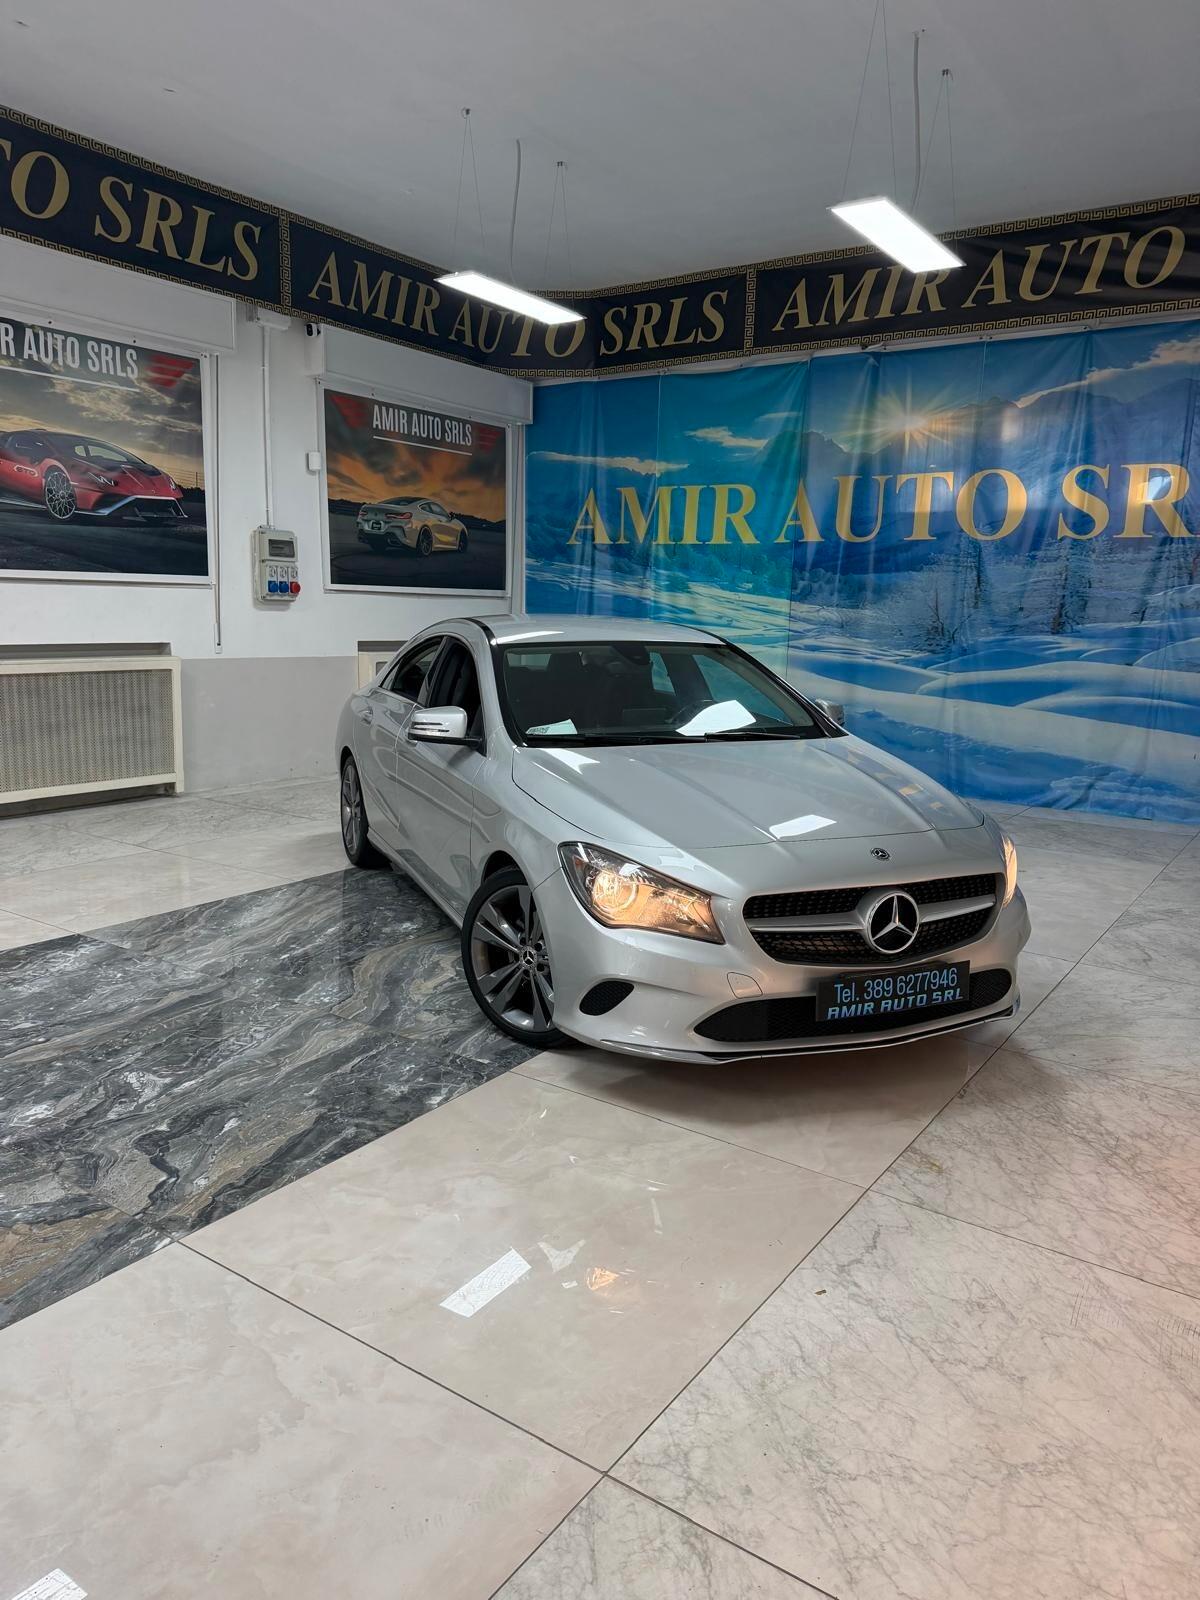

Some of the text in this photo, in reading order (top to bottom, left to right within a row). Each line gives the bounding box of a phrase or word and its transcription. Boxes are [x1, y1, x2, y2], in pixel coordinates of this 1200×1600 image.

[94, 175, 262, 281] SRLS
[307, 251, 728, 358] AMIR AUTO SRLS
[771, 225, 1186, 332] AMIR AUTO
[23, 327, 80, 369] AUTO
[87, 340, 139, 380] SRLS
[373, 404, 473, 446] AMIR AUTO SRLS
[566, 483, 761, 545] AMIR
[774, 468, 1028, 543] AUTO
[827, 987, 964, 1020] AMIR AUTO SRL
[834, 967, 958, 1004] Tel. 389 6277946
